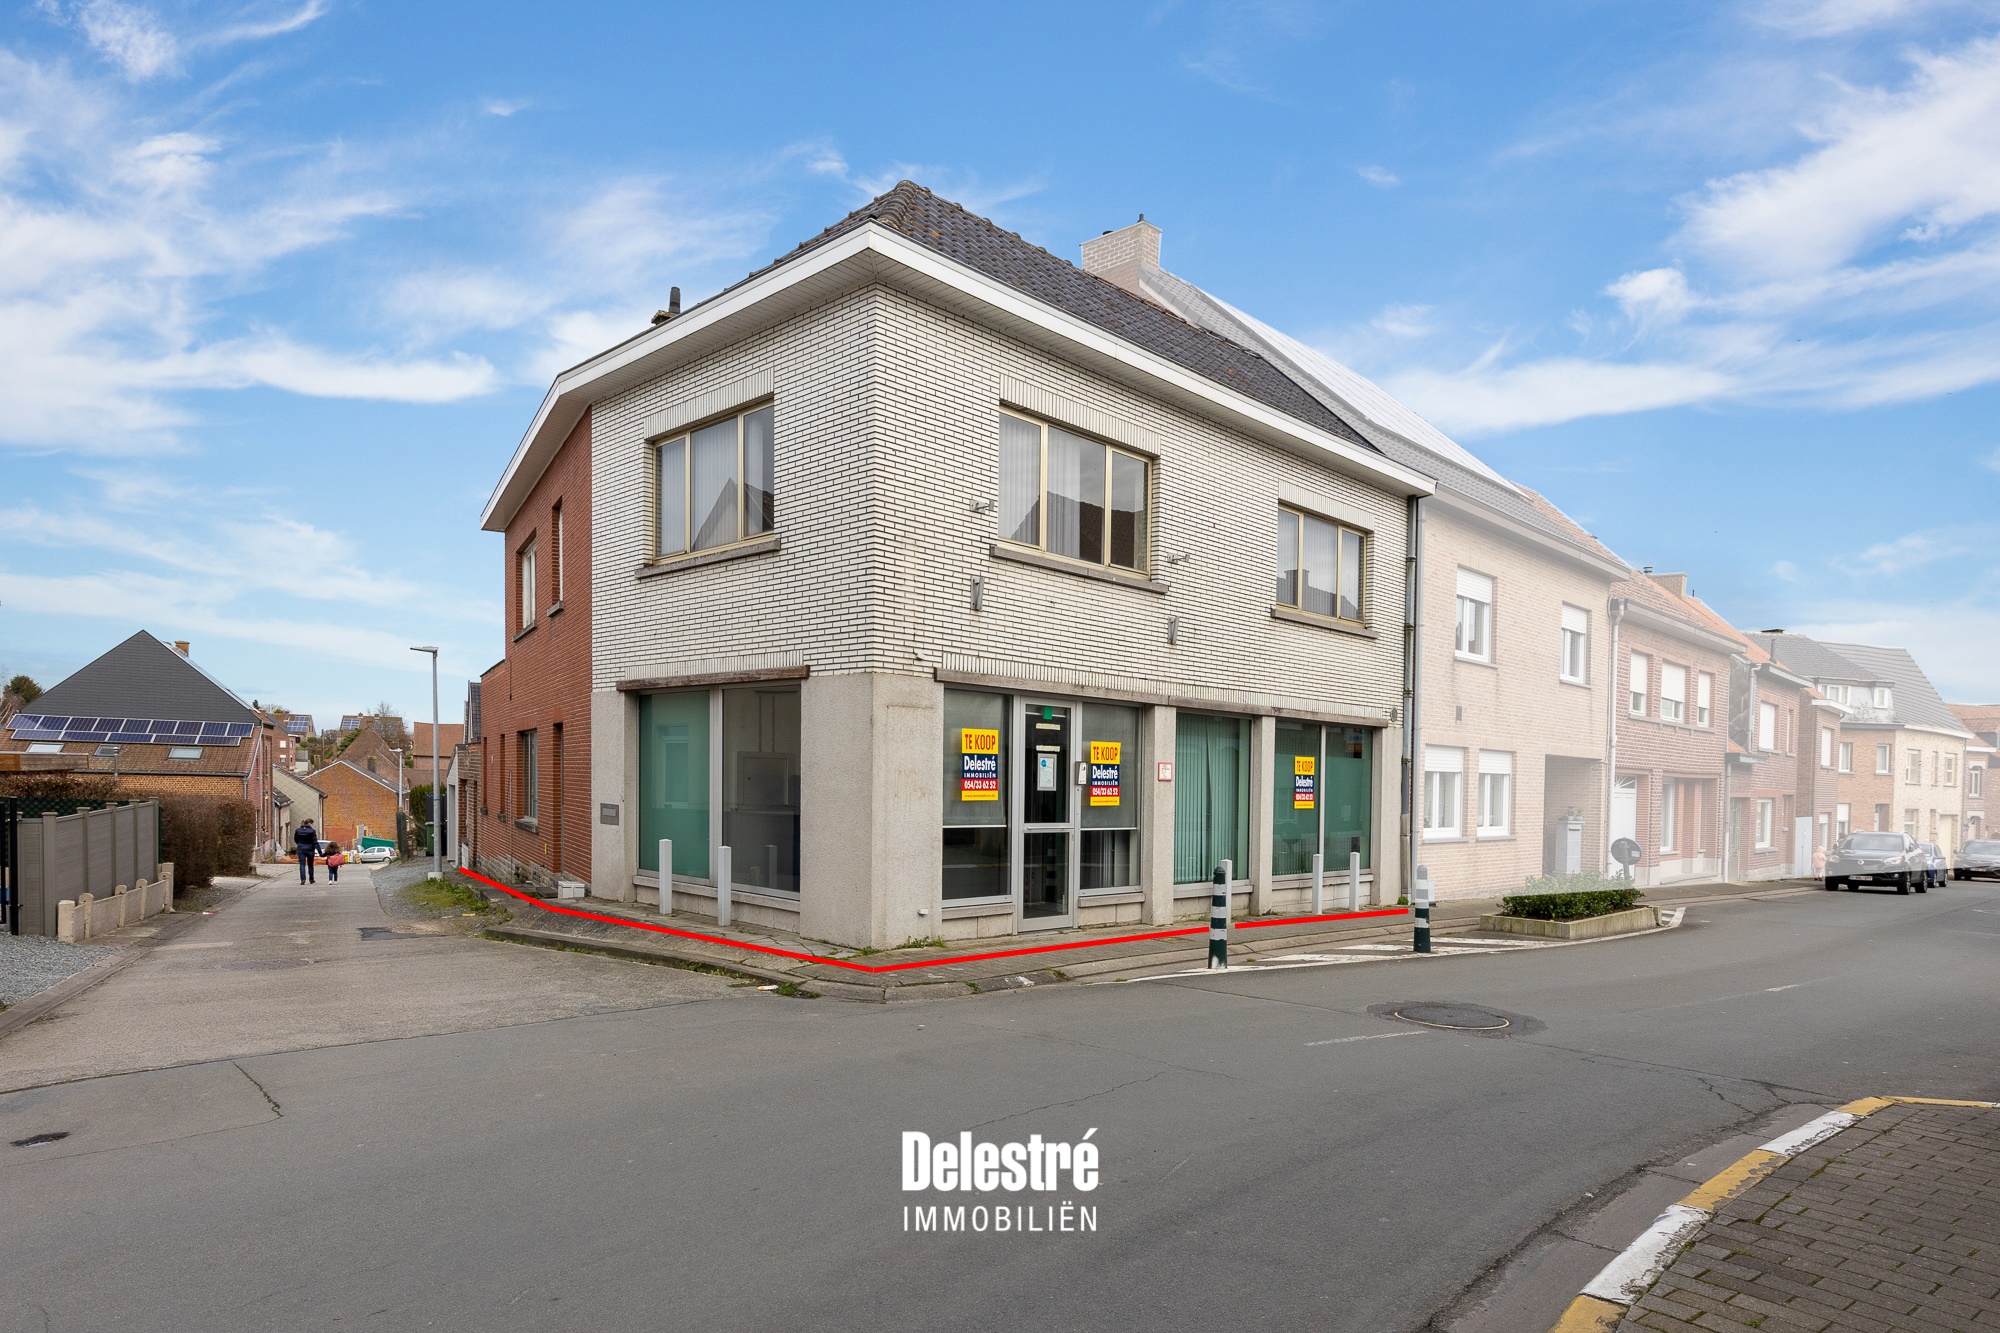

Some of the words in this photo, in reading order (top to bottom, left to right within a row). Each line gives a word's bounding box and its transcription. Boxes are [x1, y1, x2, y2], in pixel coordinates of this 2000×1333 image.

[965, 734, 972, 749] TE
[974, 734, 996, 750] KOOP
[1093, 746, 1099, 760] TE
[1101, 746, 1118, 760] KOOP
[964, 754, 996, 770] Delestré
[1092, 765, 1118, 779] Delestré
[964, 780, 982, 789] 054/33
[982, 780, 989, 789] 62
[990, 780, 996, 789] 52
